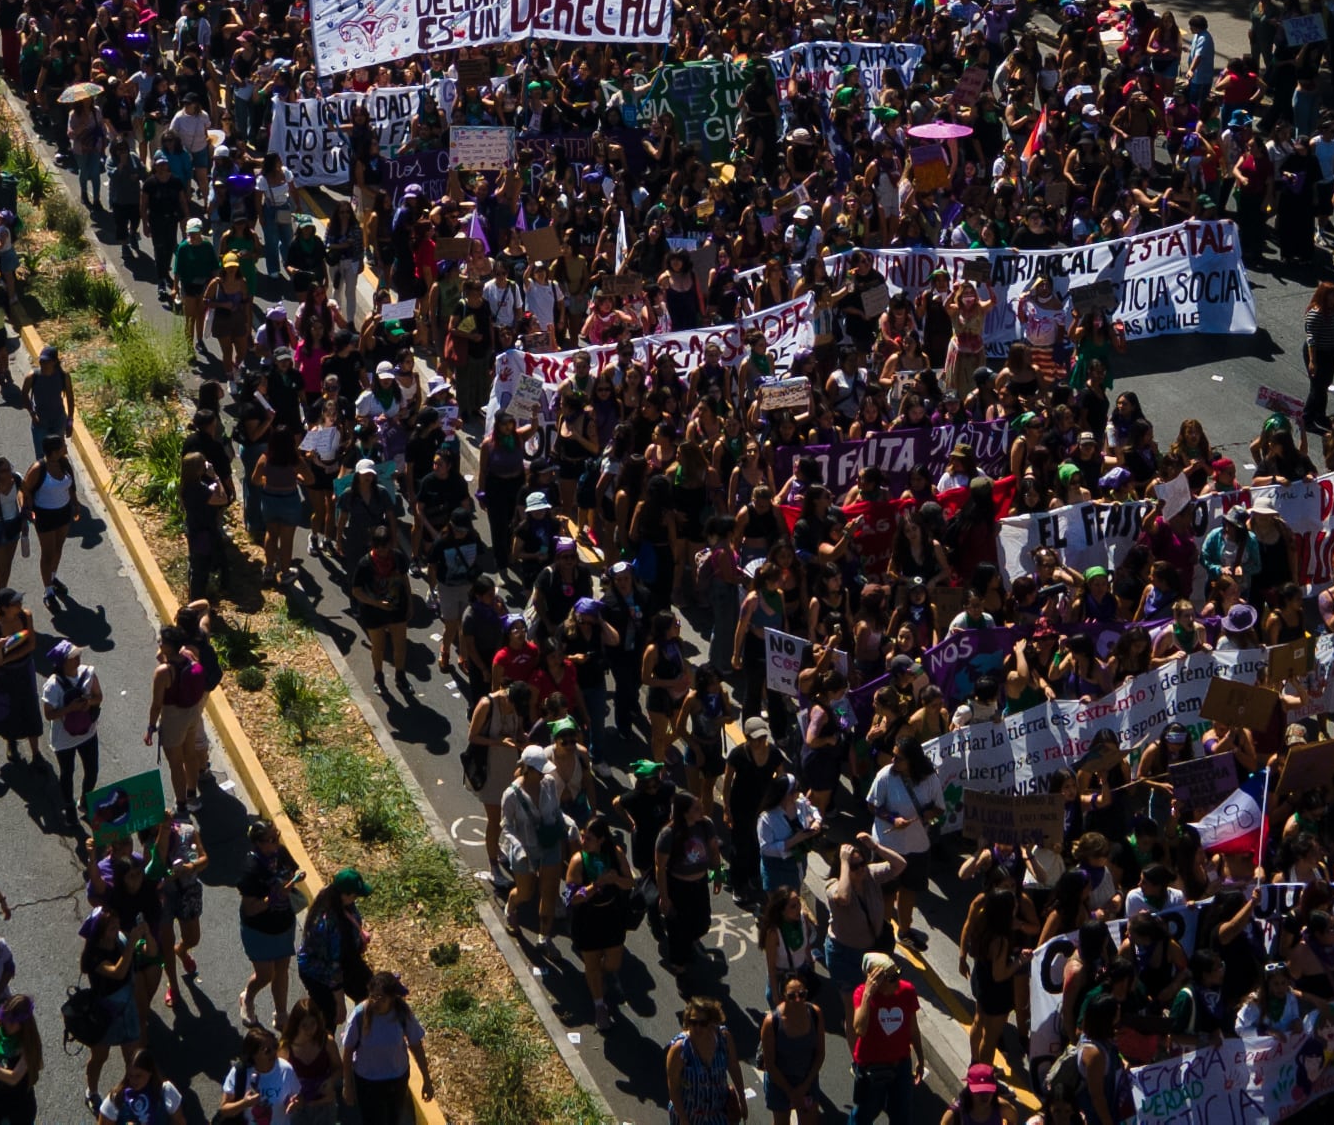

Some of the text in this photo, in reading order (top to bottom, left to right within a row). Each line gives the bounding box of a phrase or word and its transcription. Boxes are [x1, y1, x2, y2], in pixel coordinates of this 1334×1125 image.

[417, 15, 456, 51] ES
[468, 8, 501, 42] UN
[812, 45, 851, 66] PASO
[285, 104, 312, 128] LA
[285, 129, 317, 153] NO
[286, 155, 314, 177] ES
[989, 248, 1099, 287] ATRIARCAL
[1125, 223, 1235, 267] ESTATAL
[1175, 267, 1248, 305] SOCIAL
[1146, 311, 1200, 335] UCHILE
[837, 436, 916, 487] FALTA
[1038, 512, 1066, 550] EL
[769, 633, 796, 656] NO
[930, 636, 974, 673] NOS
[940, 733, 988, 759] cuidar
[991, 729, 1005, 748] la
[1007, 717, 1048, 741] tierra
[1051, 711, 1071, 727] es
[1075, 688, 1146, 724] extremo
[1147, 684, 1158, 701] y
[1160, 661, 1231, 691] defender
[959, 759, 1022, 782] cuerpos
[1025, 750, 1041, 767] es
[1141, 1080, 1204, 1117] VERDAD
